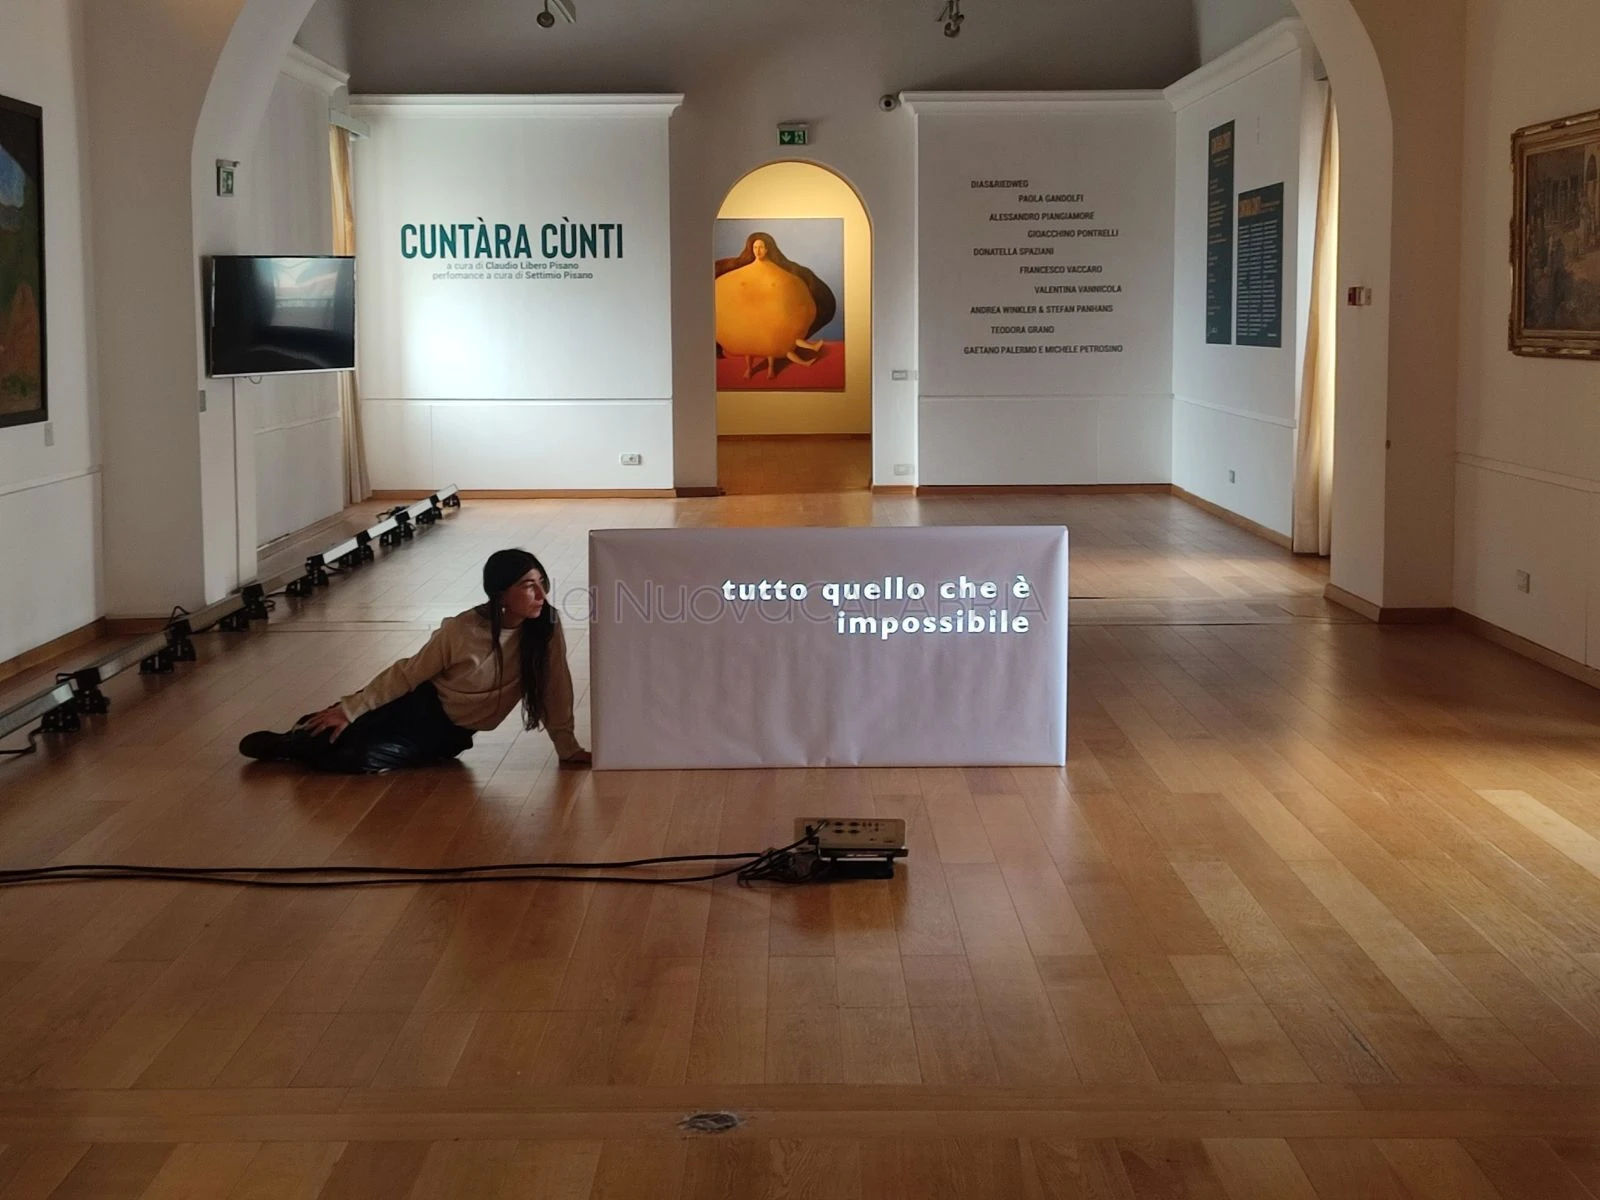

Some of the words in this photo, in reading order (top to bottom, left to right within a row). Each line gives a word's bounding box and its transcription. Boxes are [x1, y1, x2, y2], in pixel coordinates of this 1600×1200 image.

[971, 180, 1029, 188] DIAS&RIEDWEG
[1018, 194, 1043, 203] PAOLA
[1045, 194, 1084, 202] GANDOLFI
[989, 213, 1040, 221] ALESSANDRO
[1041, 212, 1095, 220] PIANGIAMORE
[400, 217, 532, 259] CUNTÀRA
[541, 216, 624, 259] CÙNTI
[1027, 230, 1075, 238] GIOACCHINO
[1077, 229, 1119, 237] PONTRELLI
[973, 248, 1018, 256] DONATELLA
[1019, 247, 1054, 255] SPAZIANI
[476, 262, 483, 270] di
[485, 262, 518, 270] Claudio
[520, 262, 547, 270] Libero
[549, 262, 579, 270] Pisano
[1019, 266, 1065, 274] FRANCESCO
[1067, 265, 1103, 273] VACCARO
[432, 271, 485, 280] perfomance
[515, 271, 524, 280] di
[525, 271, 562, 280] Settimio
[563, 271, 594, 280] Pisano
[1034, 286, 1077, 294] VALENTINA
[1078, 285, 1122, 293] VANNICOLA
[970, 306, 1001, 314] ANDREA
[1003, 306, 1037, 314] WINKLER
[1038, 305, 1044, 313] &
[1046, 305, 1075, 313] STEFAN
[1076, 305, 1114, 313] PANHANS
[991, 326, 1027, 334] TEODORA
[963, 346, 1000, 354] GAETANO
[1001, 346, 1037, 354] PALERMO
[1038, 346, 1043, 354] E
[1045, 345, 1078, 354] MICHELE
[1079, 345, 1123, 353] PETROSINO
[721, 579, 809, 601] tutto
[822, 577, 927, 606] quello
[939, 576, 997, 601] che
[1012, 575, 1031, 600] è
[836, 610, 1031, 640] impossibile
